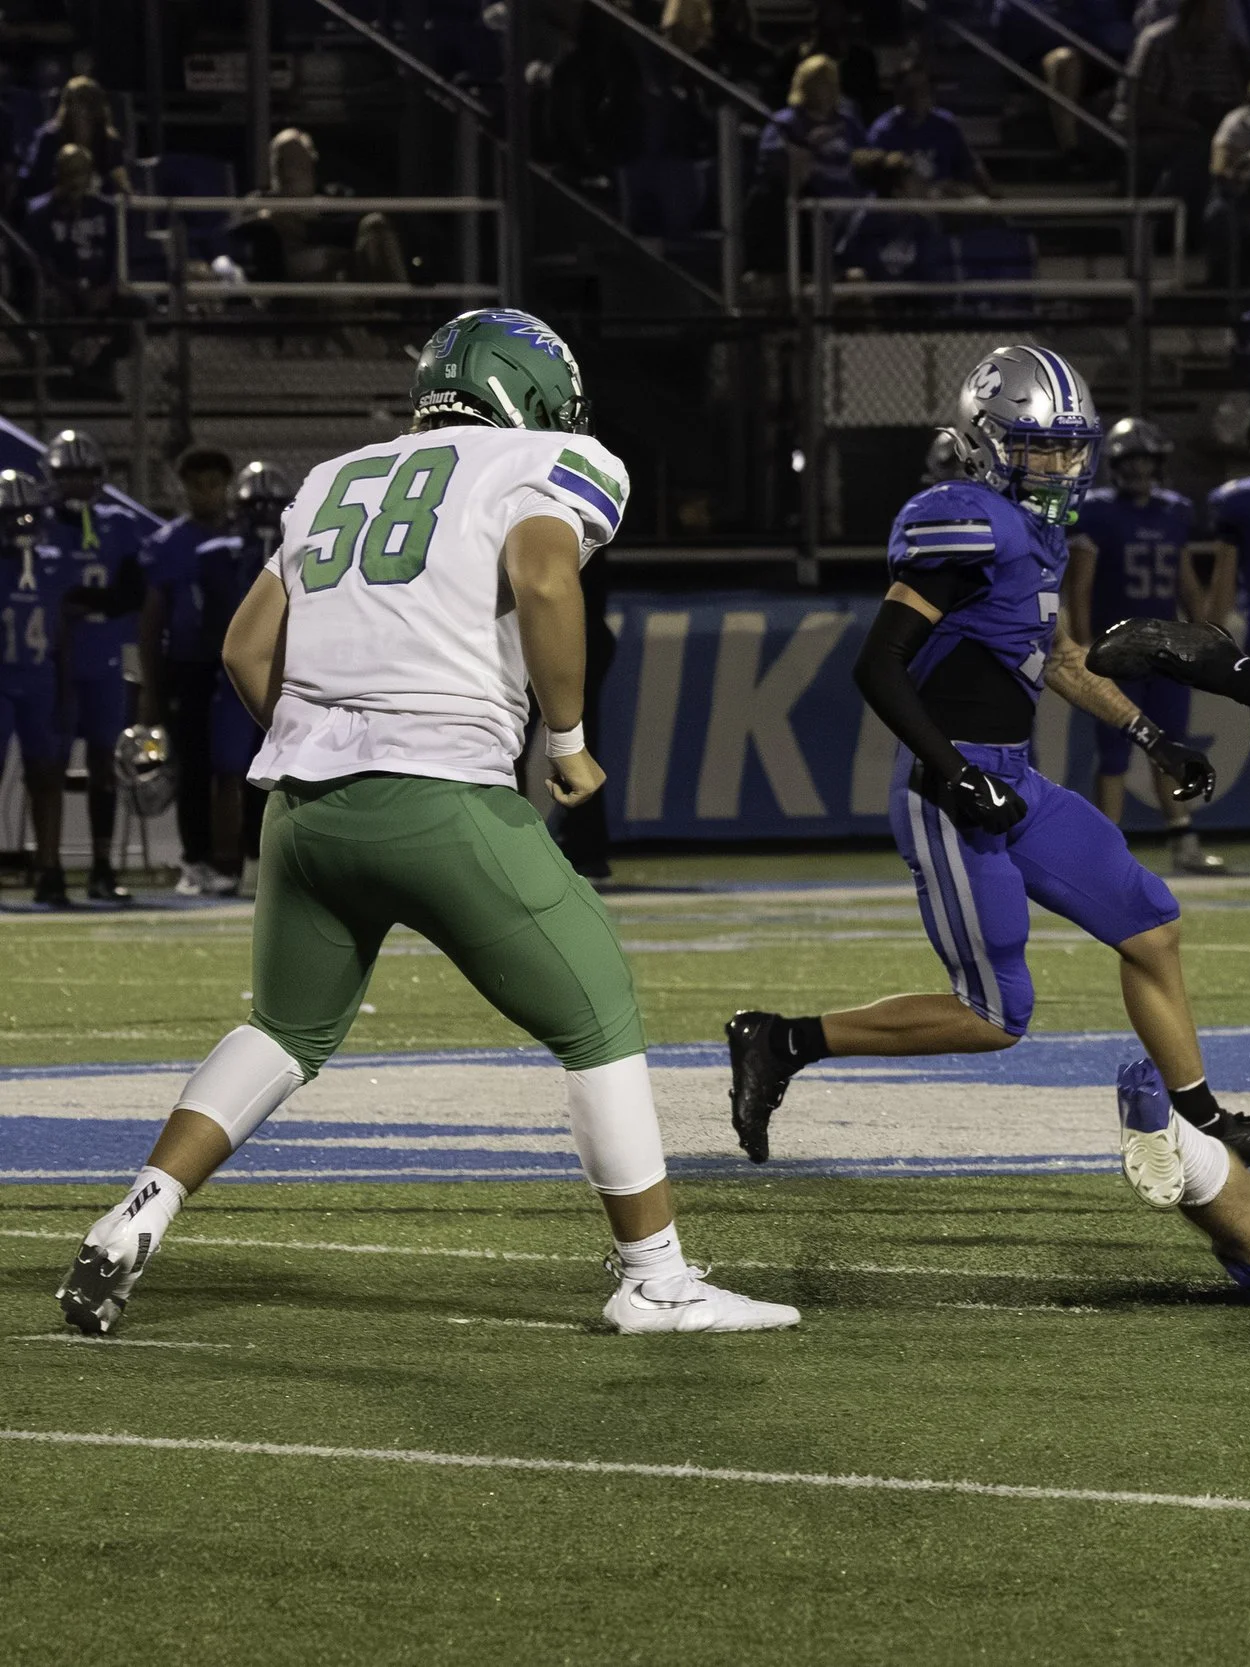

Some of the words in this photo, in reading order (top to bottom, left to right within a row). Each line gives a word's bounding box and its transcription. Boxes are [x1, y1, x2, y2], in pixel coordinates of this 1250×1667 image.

[445, 363, 457, 378] 58
[419, 390, 457, 406] schutt
[300, 444, 459, 594] 58
[1123, 541, 1178, 599] 55
